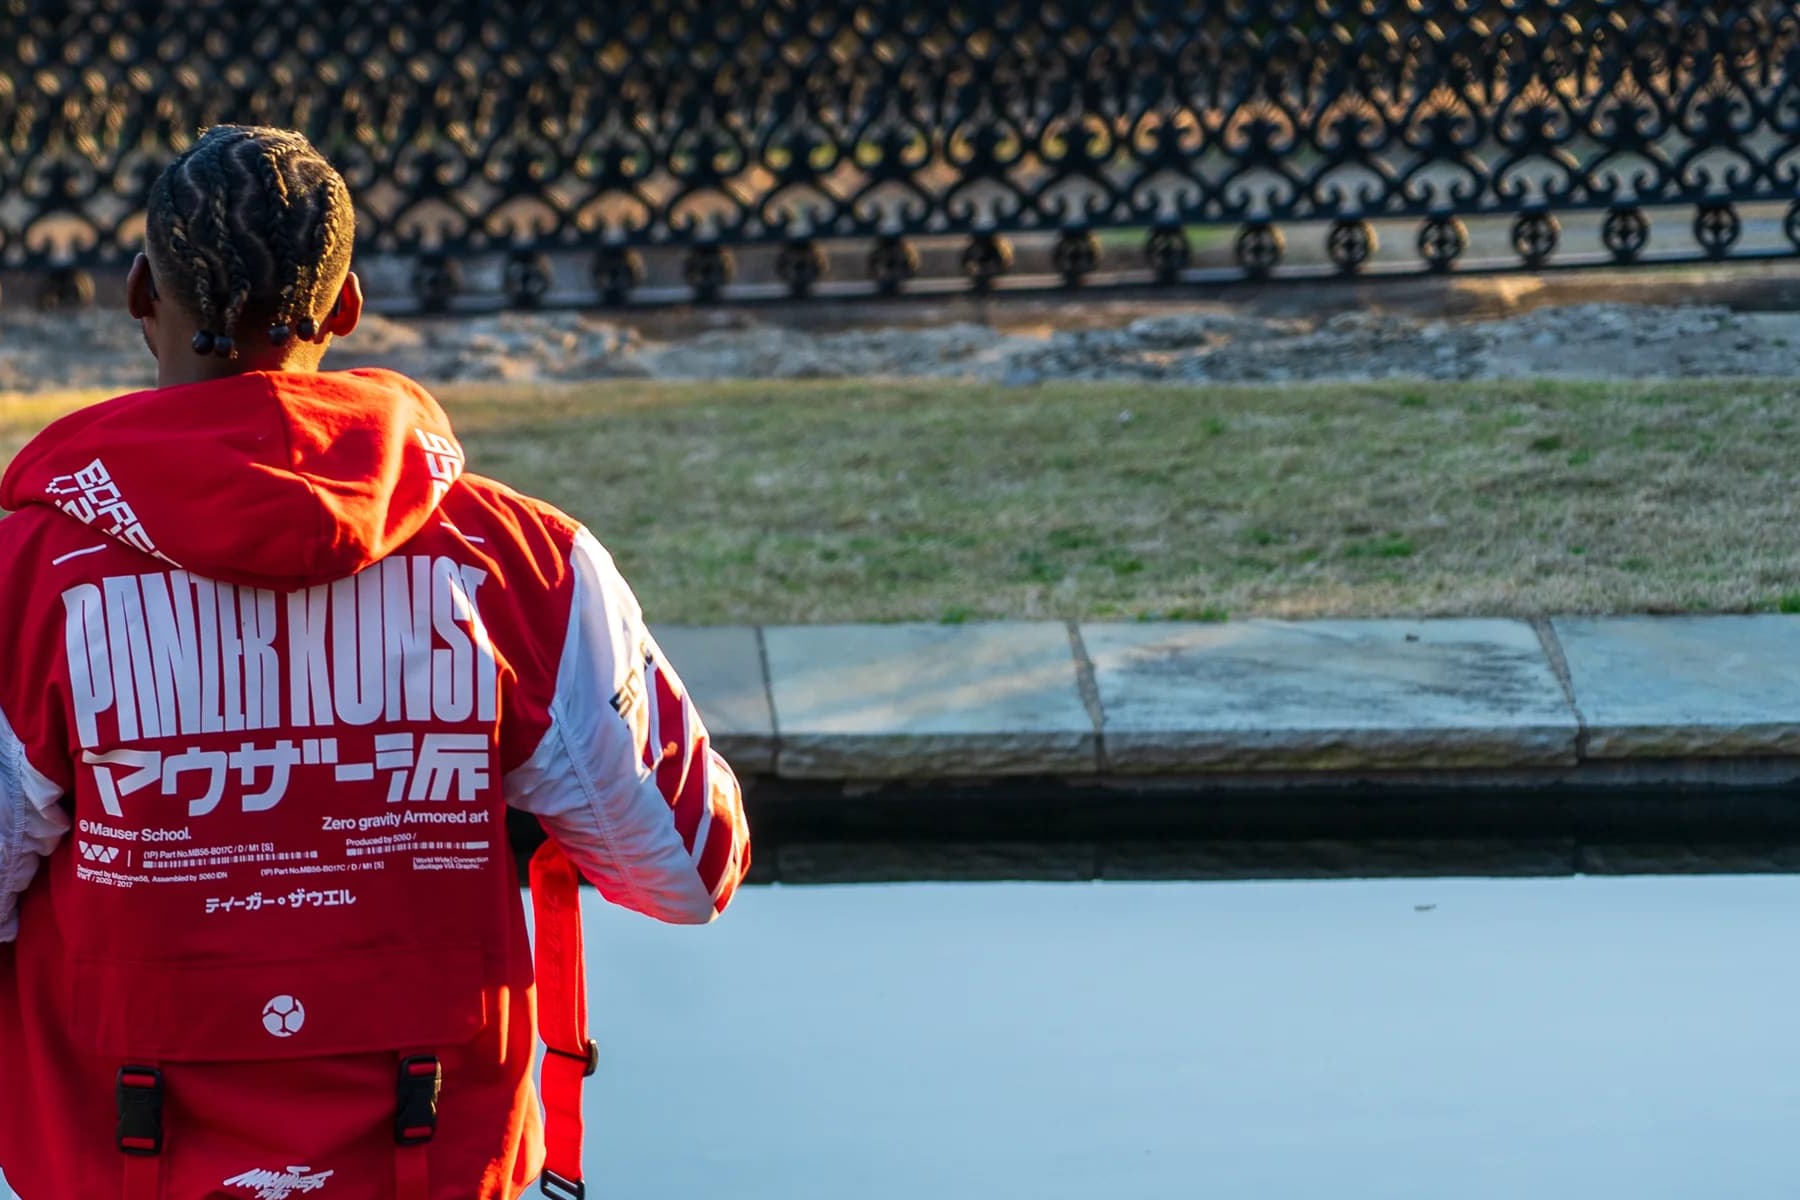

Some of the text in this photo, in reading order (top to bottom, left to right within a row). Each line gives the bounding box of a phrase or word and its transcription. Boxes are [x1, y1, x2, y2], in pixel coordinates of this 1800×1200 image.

[61, 554, 498, 748] PANZER KUNST
[322, 809, 489, 831] Zero gravity Armored art
[346, 836, 384, 847] Produced
[384, 836, 393, 846] by
[159, 849, 176, 860] Part
